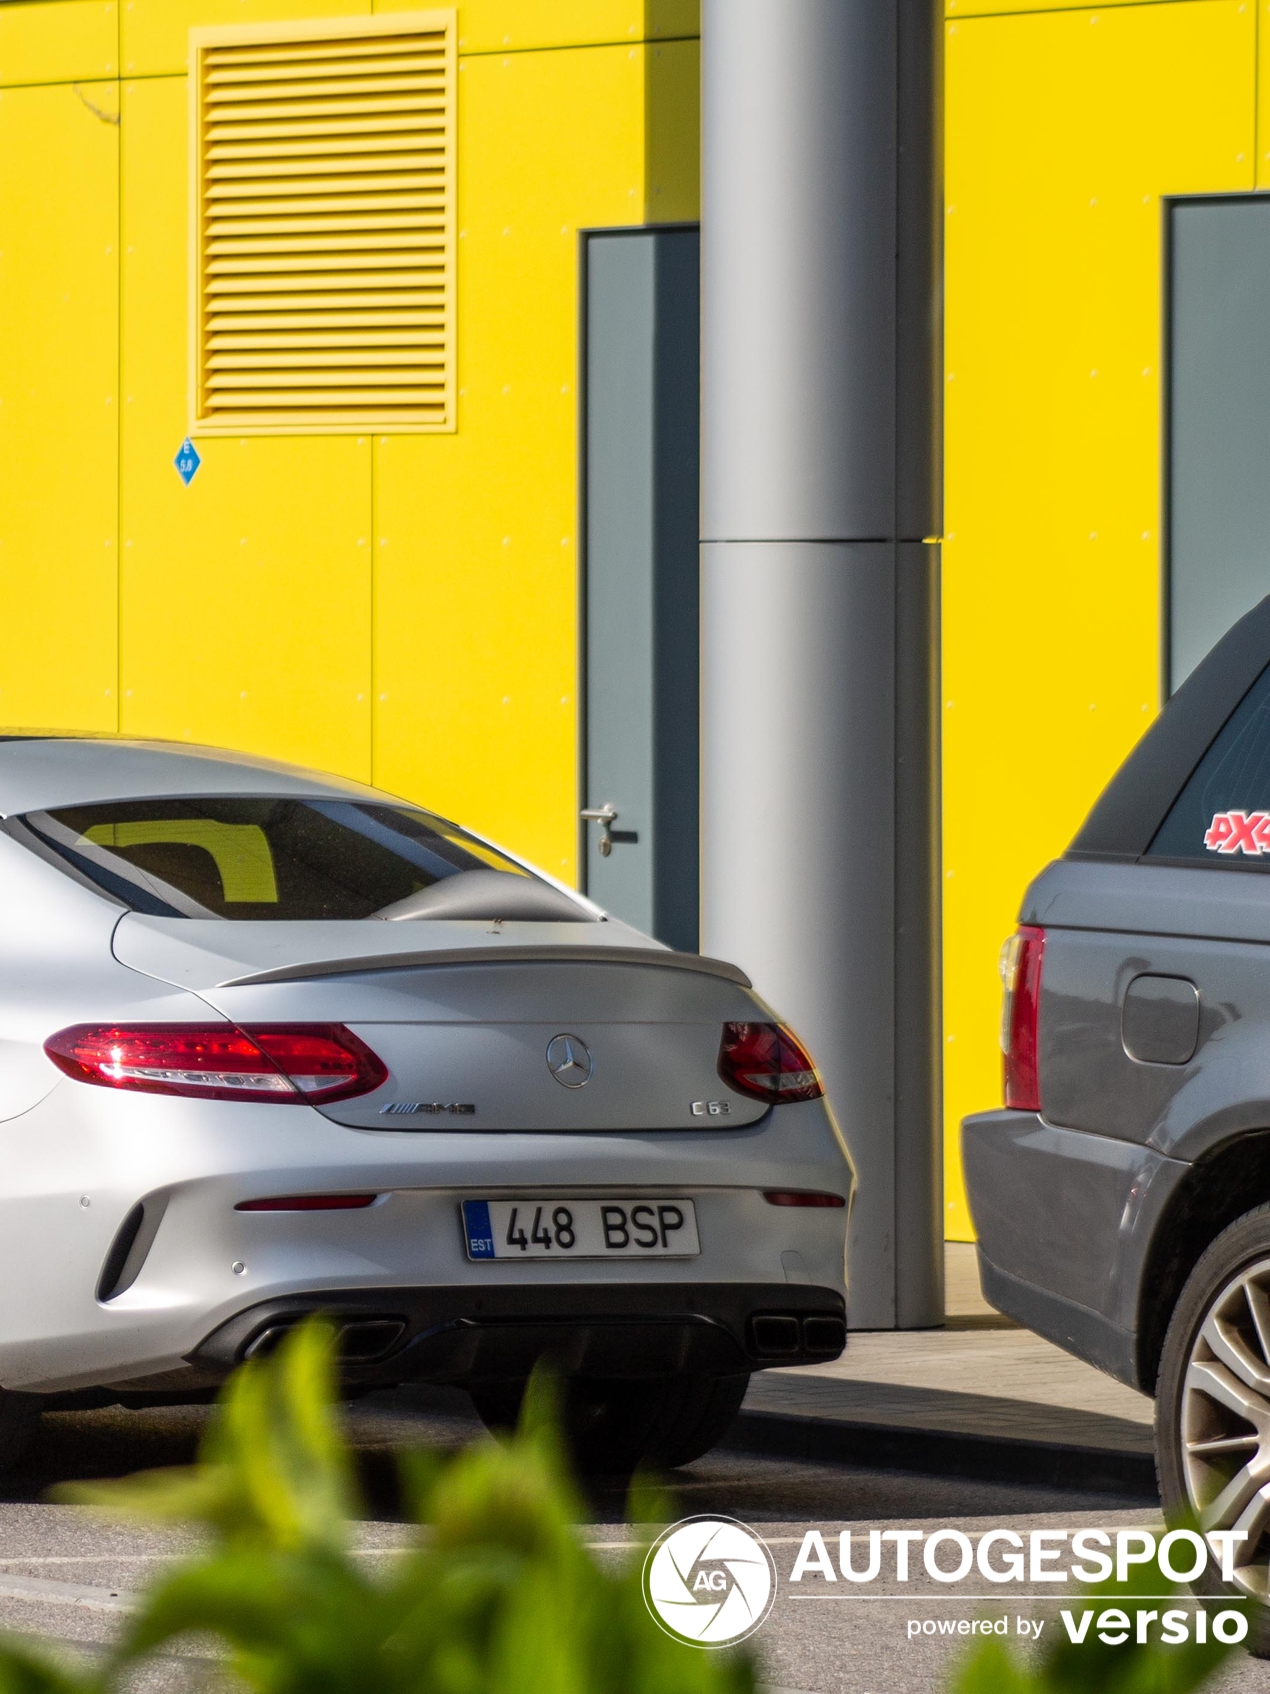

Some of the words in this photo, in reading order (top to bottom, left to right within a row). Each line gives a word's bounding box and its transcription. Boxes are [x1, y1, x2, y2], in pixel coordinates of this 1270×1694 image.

[183, 440, 191, 454] E
[690, 1101, 704, 1116] C
[706, 1101, 731, 1115] 63
[506, 1206, 575, 1250] 448
[600, 1205, 684, 1248] BSP
[470, 1238, 492, 1251] EST
